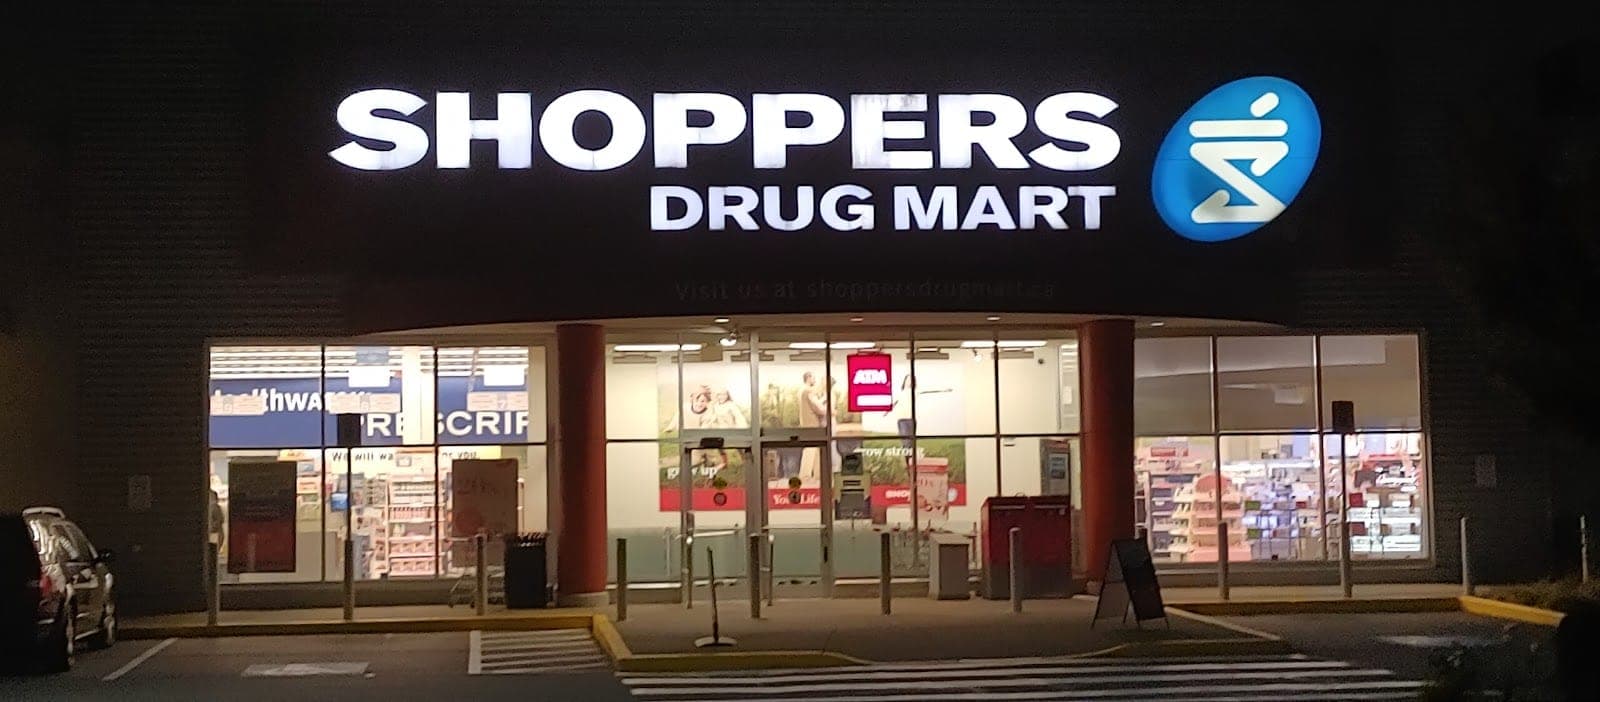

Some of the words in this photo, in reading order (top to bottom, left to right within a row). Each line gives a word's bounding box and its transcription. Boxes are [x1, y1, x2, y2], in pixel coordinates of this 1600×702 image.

[329, 88, 1120, 171] SHOPPERS
[651, 184, 874, 231] DRUG
[893, 185, 1116, 230] MART
[675, 281, 729, 302] Visit
[736, 283, 768, 301] us
[774, 281, 798, 301] at
[853, 369, 888, 385] ATM
